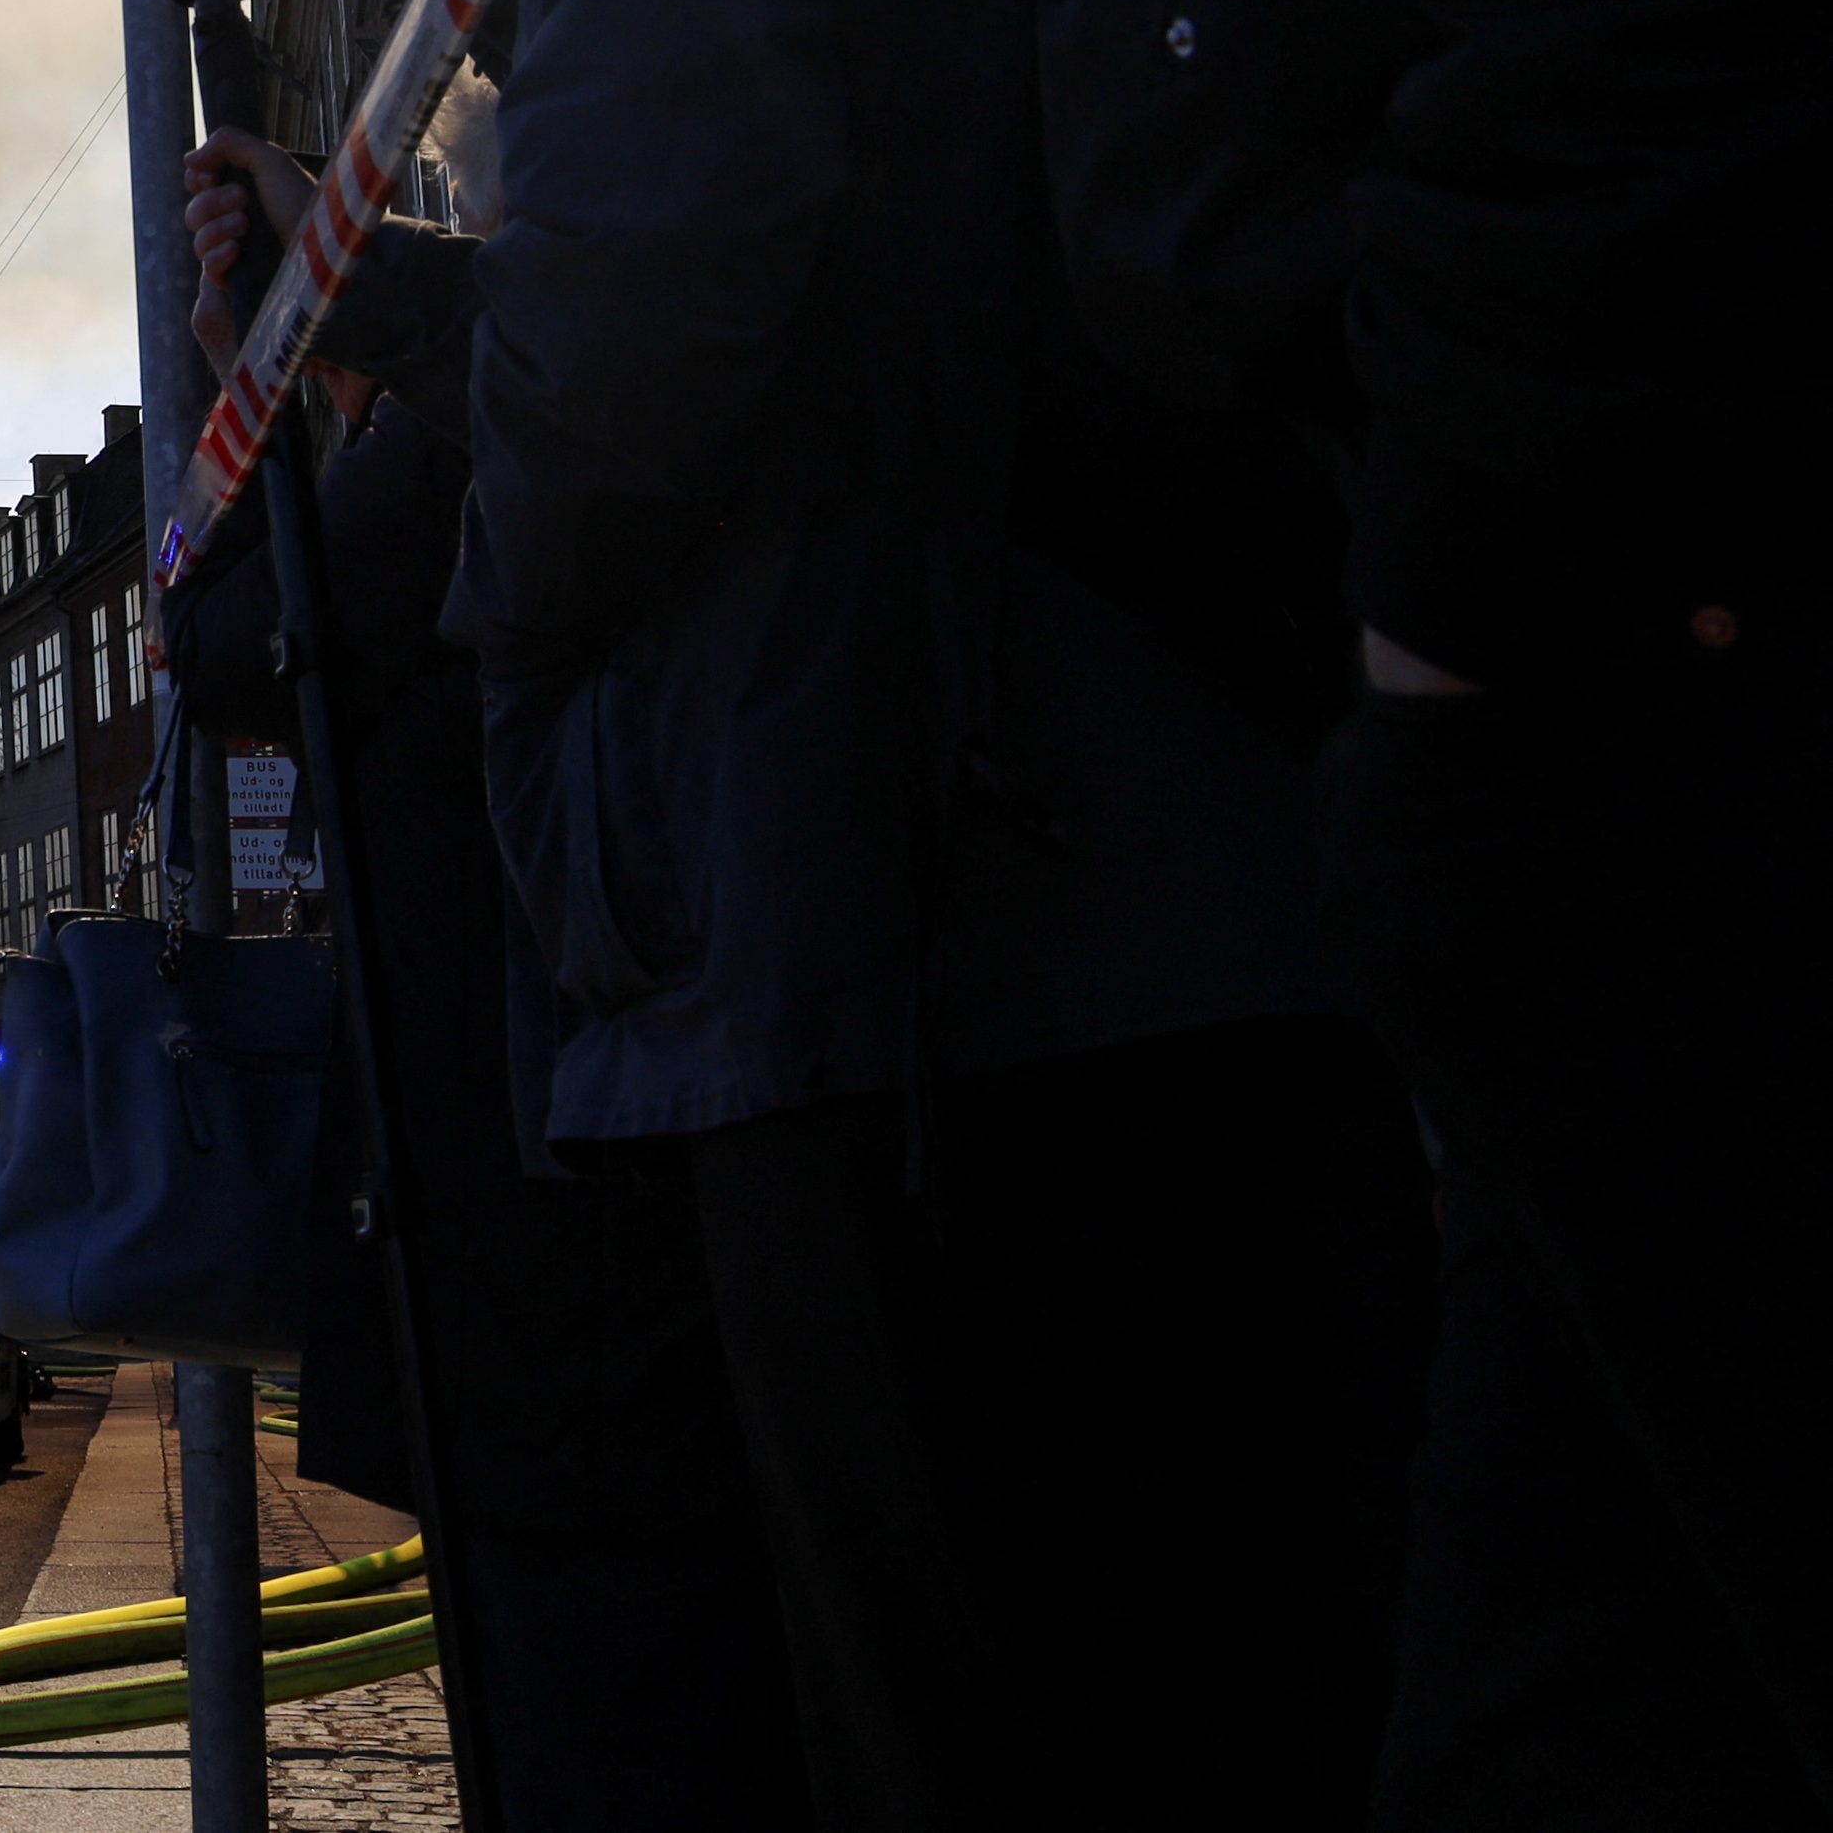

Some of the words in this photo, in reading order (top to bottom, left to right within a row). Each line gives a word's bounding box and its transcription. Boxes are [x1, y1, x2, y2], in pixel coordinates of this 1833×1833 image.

[246, 761, 277, 772] BUS
[241, 776, 262, 786] Ud-
[269, 778, 284, 786] og
[232, 790, 291, 800] ndstignin
[244, 803, 283, 812] tilladt
[240, 837, 264, 847] Ud-
[244, 869, 283, 879] tillad
